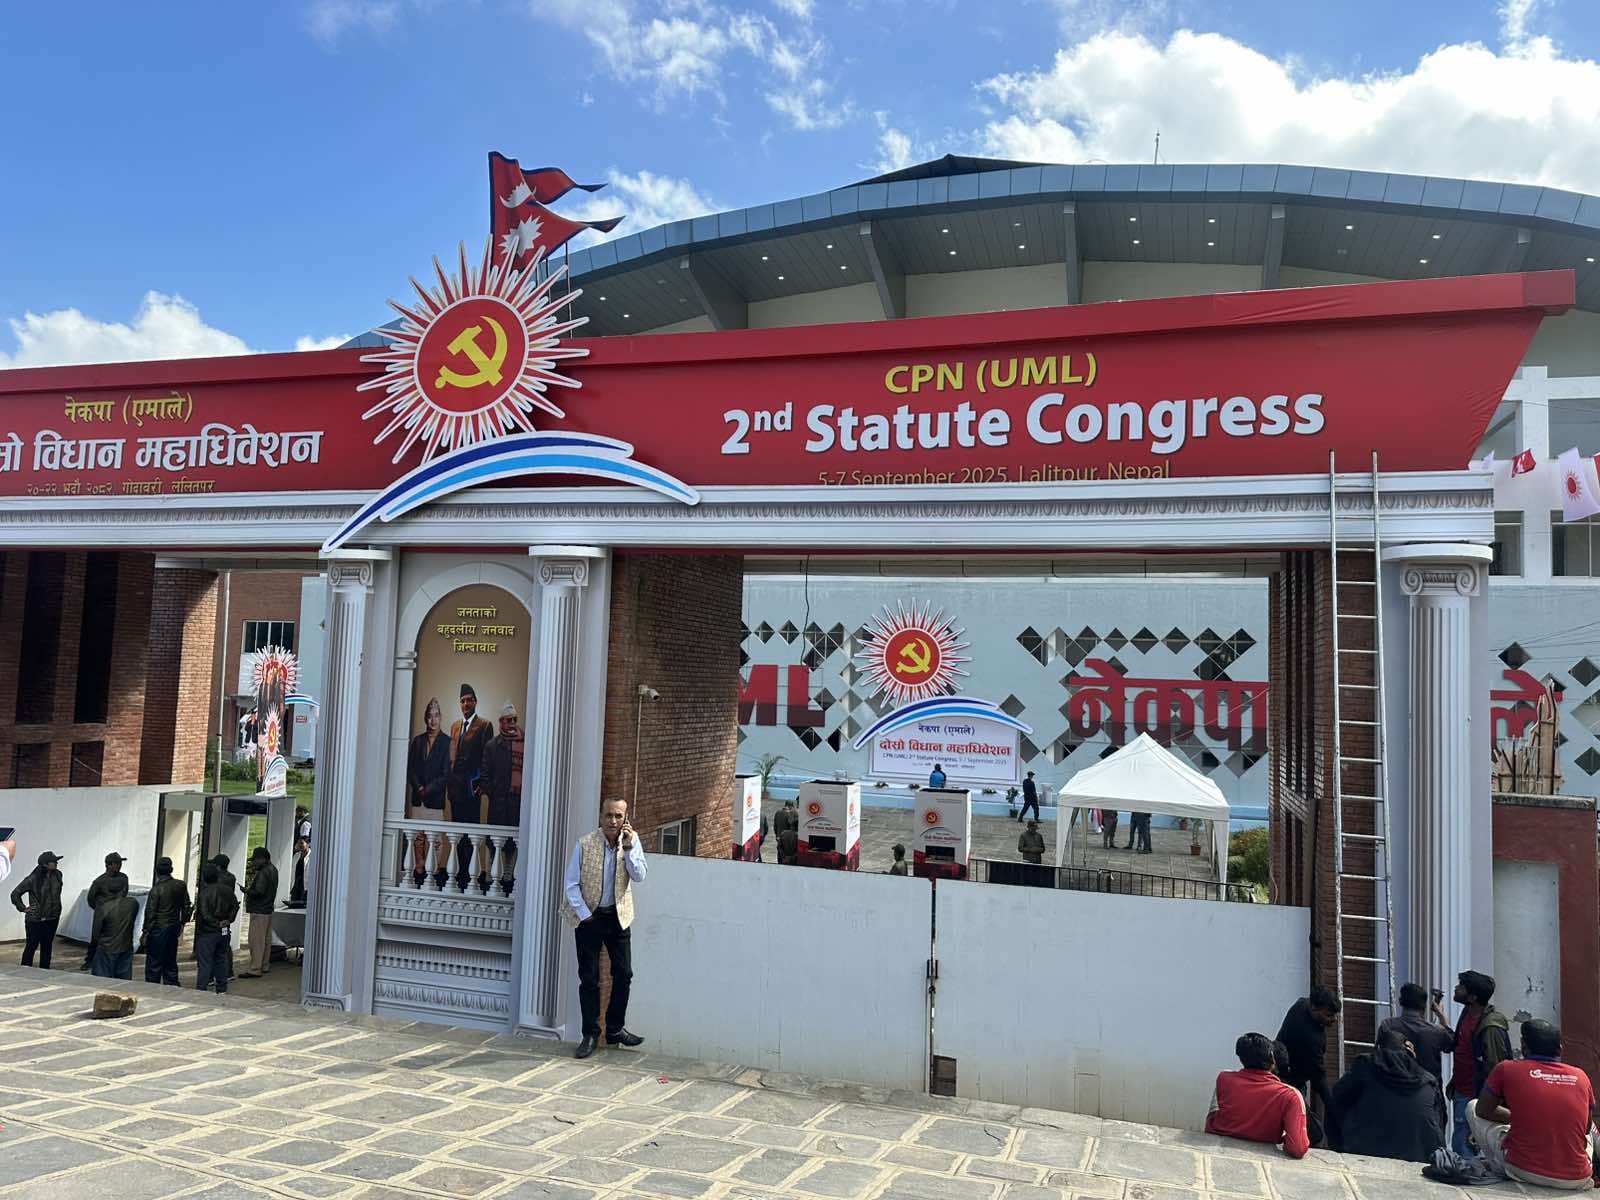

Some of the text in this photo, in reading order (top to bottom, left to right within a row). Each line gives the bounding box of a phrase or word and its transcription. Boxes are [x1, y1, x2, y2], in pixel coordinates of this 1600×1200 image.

[884, 352, 1097, 395] CPN (UML)
[64, 391, 194, 427] नेकपा (एमाले)
[720, 392, 1325, 455] 2nd Statute Congress
[33, 428, 126, 471] विधान
[134, 422, 325, 471] महाधिवेशन
[818, 471, 847, 486] 5-7
[851, 467, 955, 485] September
[1108, 459, 1170, 481] Nepal
[457, 604, 496, 618] जनताको
